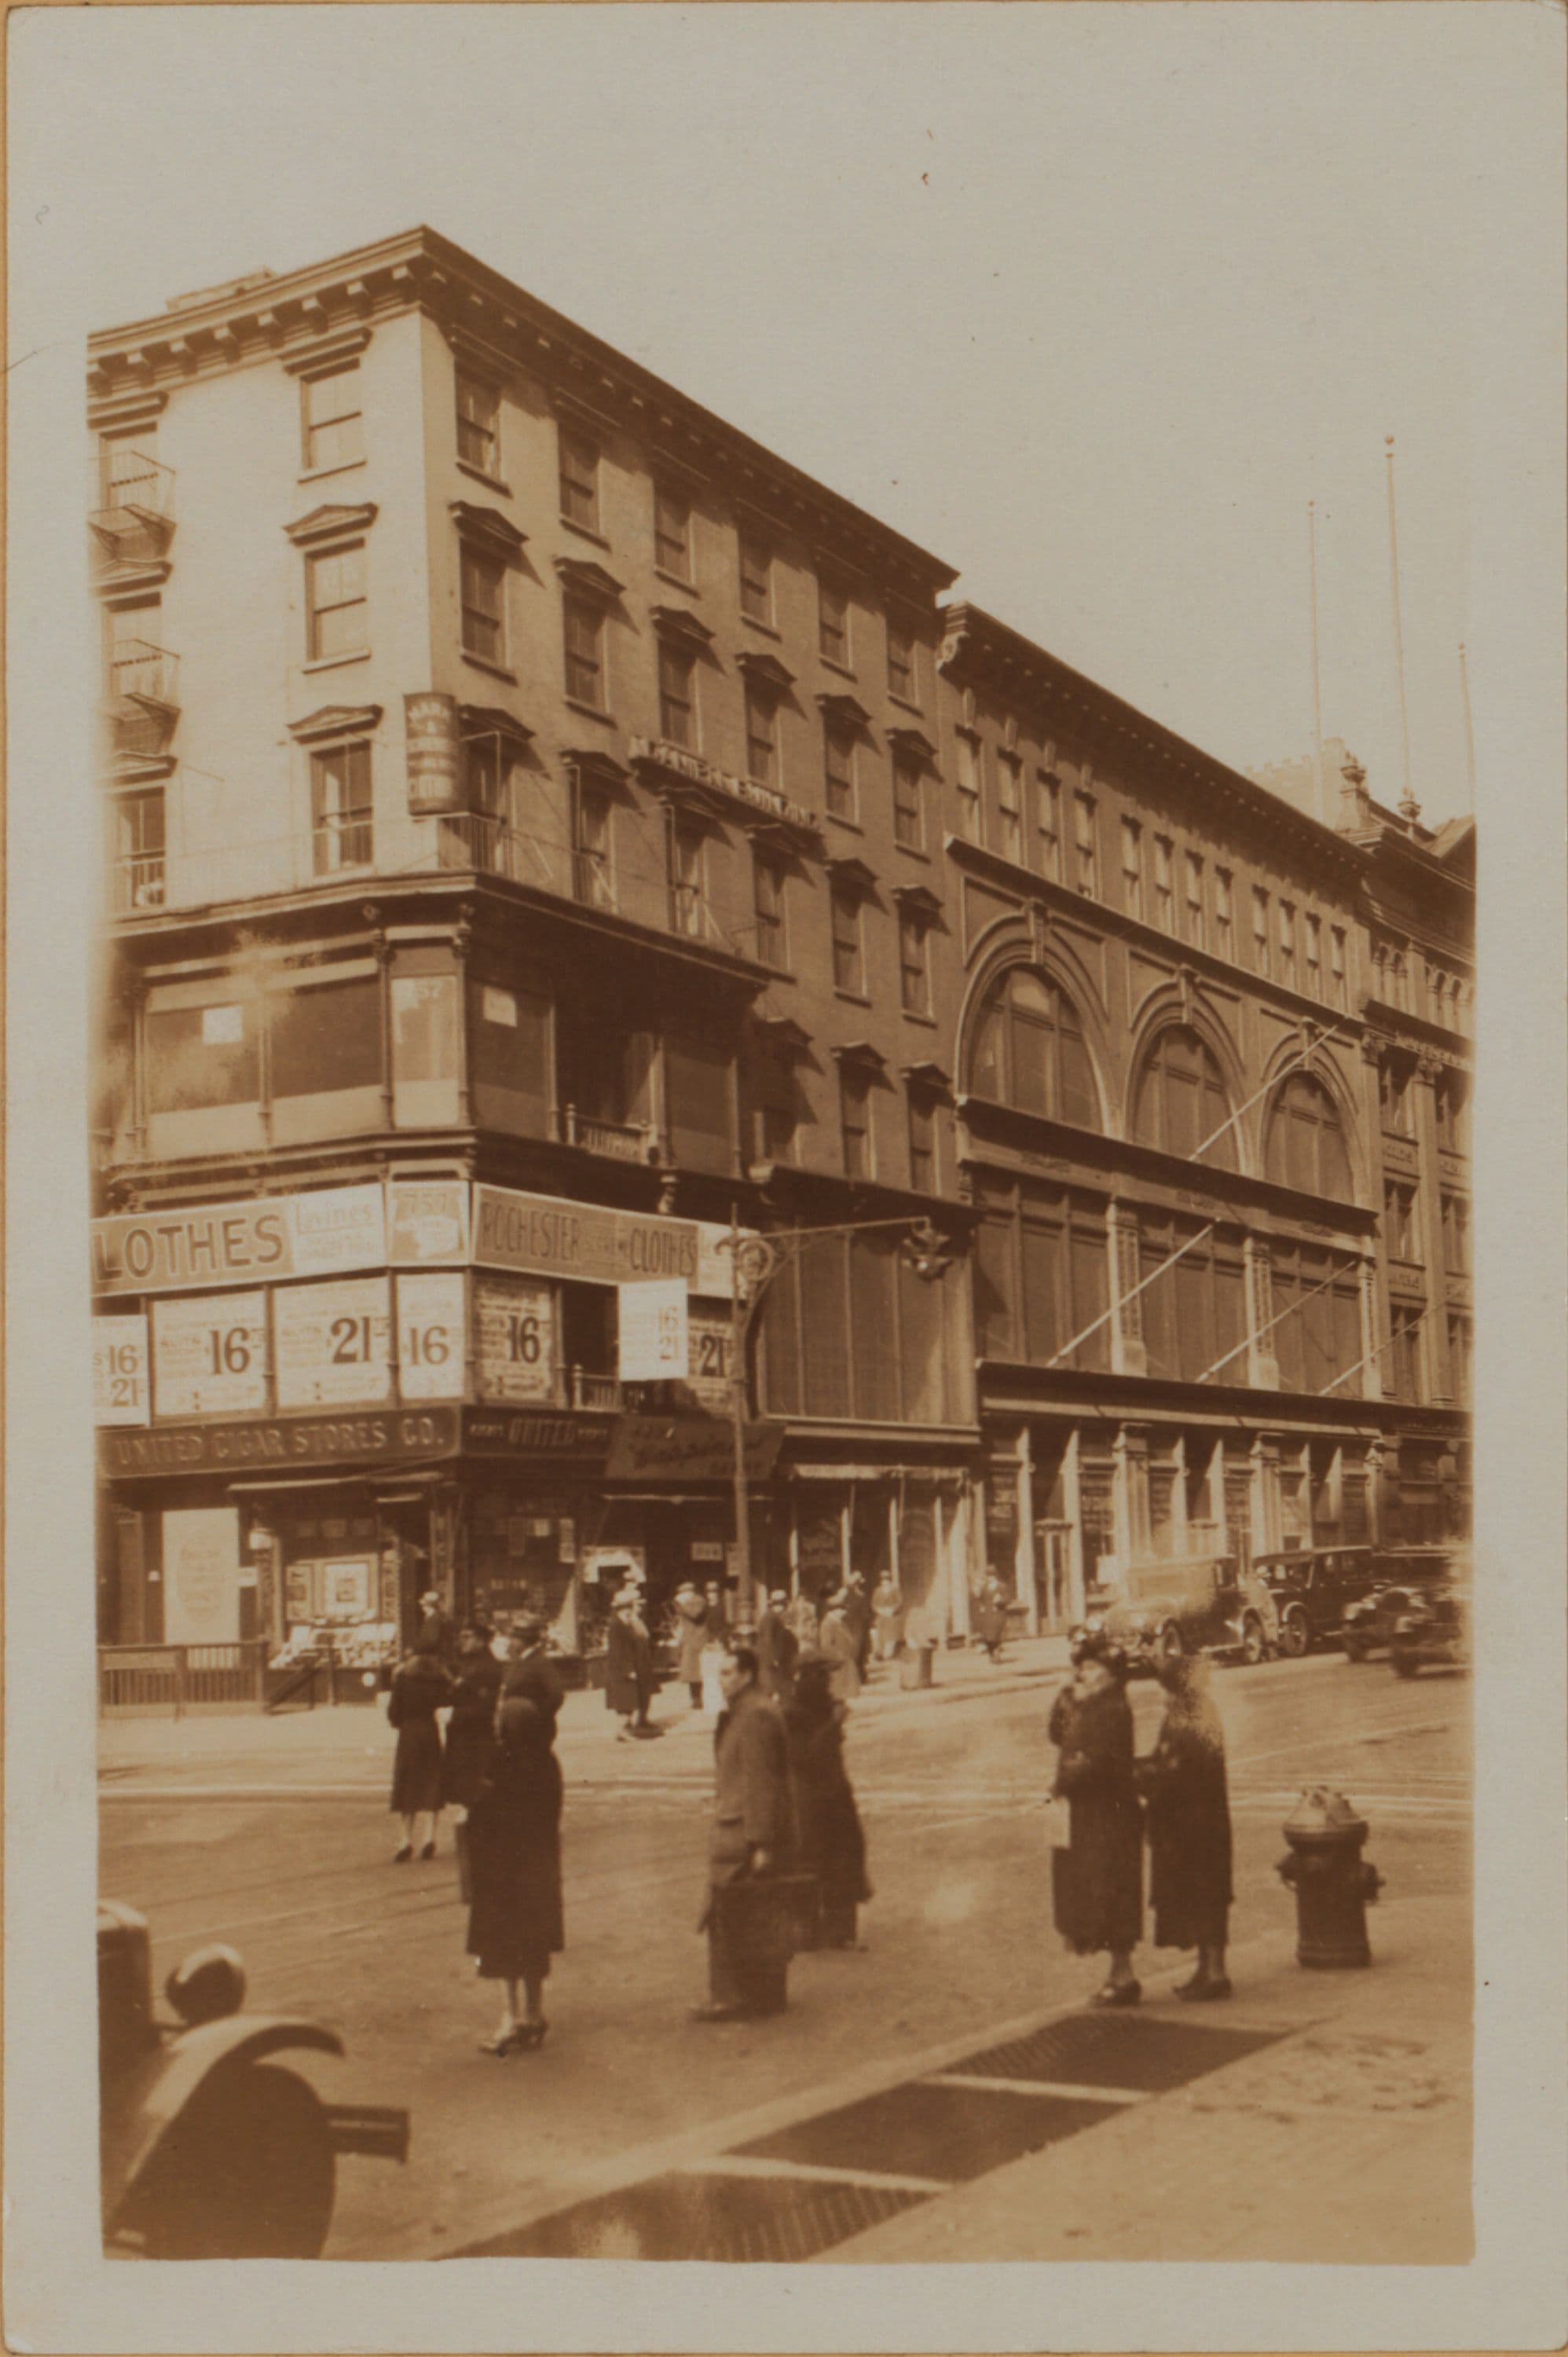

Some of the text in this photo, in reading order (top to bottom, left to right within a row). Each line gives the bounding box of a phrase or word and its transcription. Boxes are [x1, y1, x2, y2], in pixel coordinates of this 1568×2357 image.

[93, 1213, 284, 1281] LOTHES
[630, 1227, 698, 1276] CLOTHES
[108, 1344, 138, 1374] 16
[208, 1328, 251, 1375] 16
[330, 1317, 372, 1364] 21
[409, 1325, 449, 1365] 16
[508, 1315, 540, 1364] 16
[700, 1334, 725, 1377] 21
[111, 1378, 138, 1407] 21
[115, 1435, 202, 1464] UNITED
[215, 1429, 283, 1459] CIGAR
[291, 1420, 387, 1453] STORES
[401, 1417, 445, 1446] CO.
